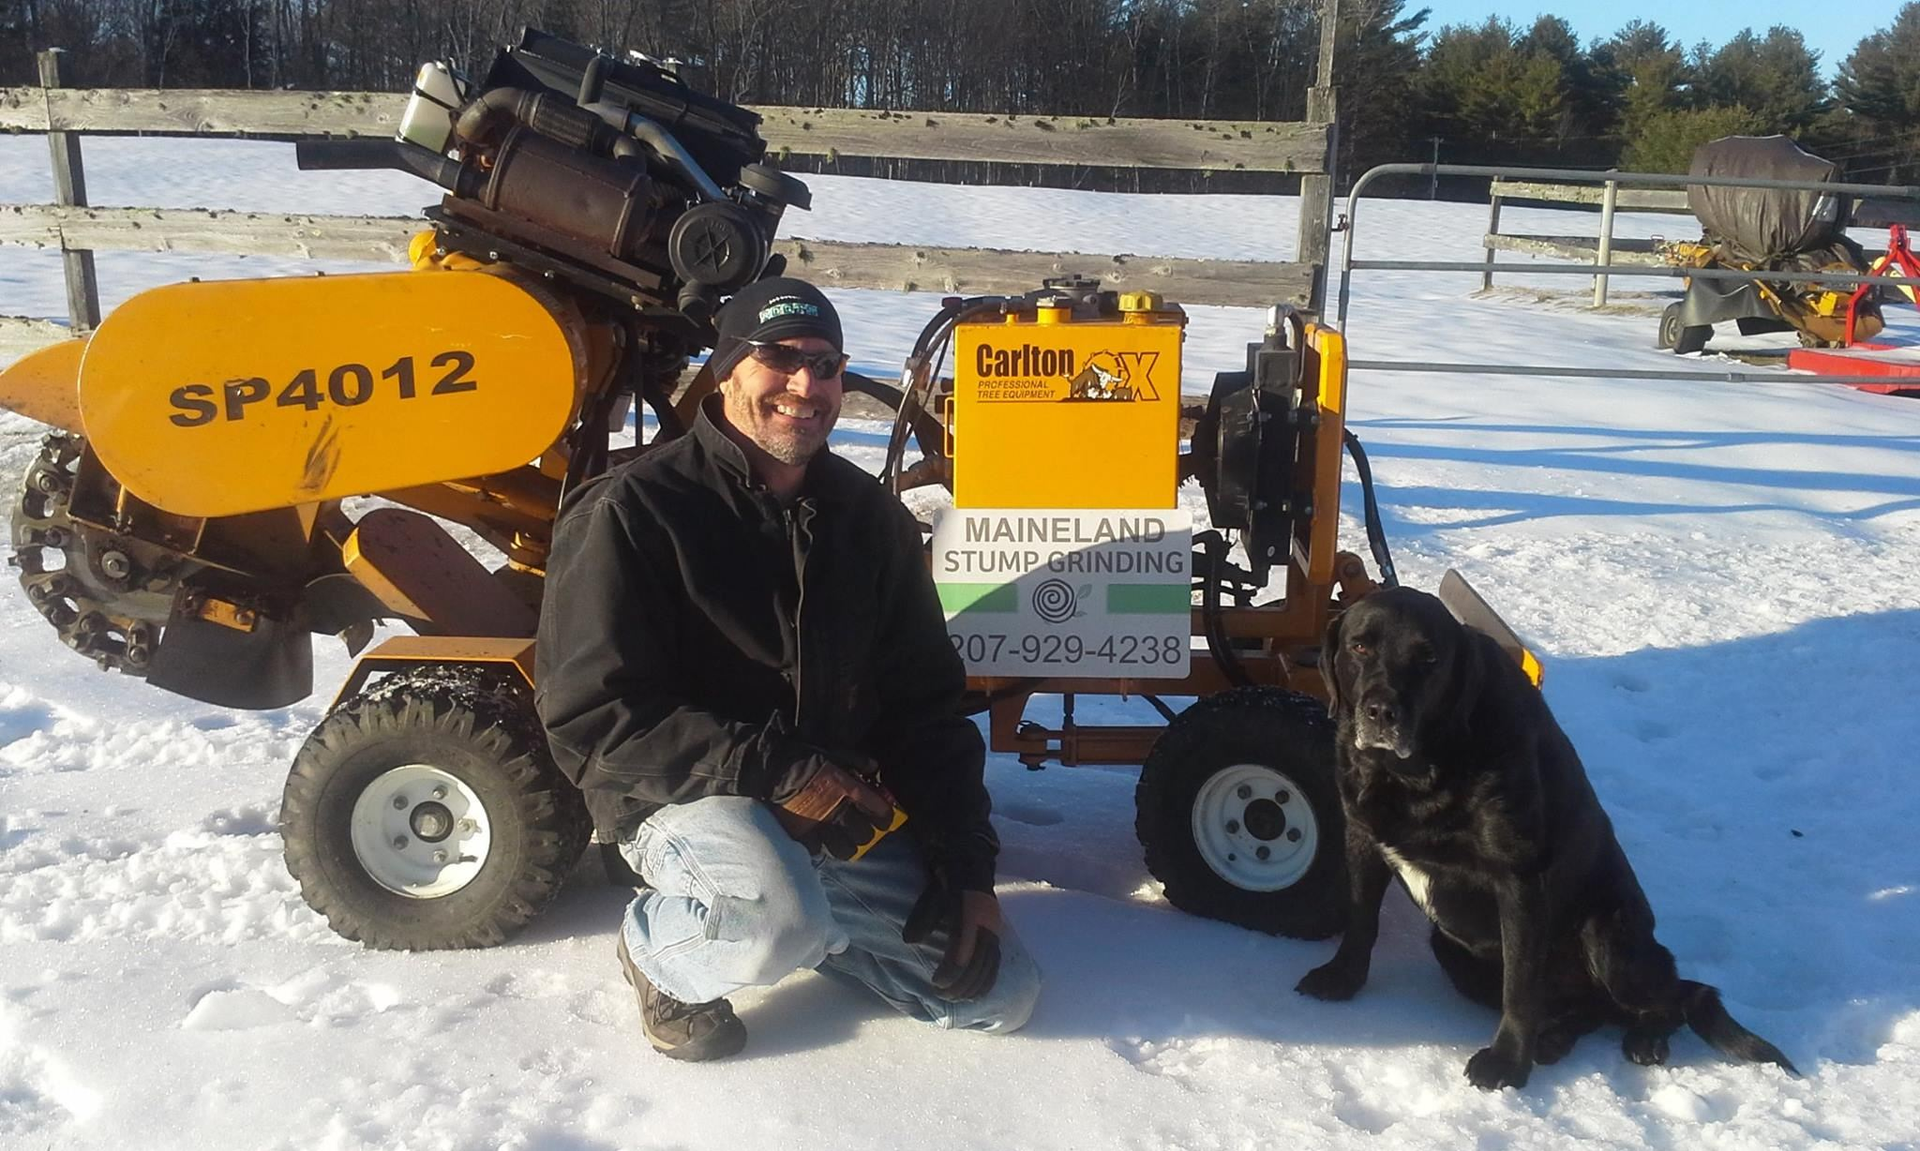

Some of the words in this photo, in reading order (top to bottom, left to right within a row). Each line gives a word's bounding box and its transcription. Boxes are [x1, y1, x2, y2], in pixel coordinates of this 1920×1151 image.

[976, 343, 1074, 378] Carlton
[168, 350, 477, 428] SP4012
[977, 380, 1049, 389] PROFESSIONAL
[977, 390, 1000, 399] TREE
[1002, 390, 1056, 399] EQUIPMENT
[965, 517, 1166, 543] MAINELAND
[944, 550, 1040, 573] STUMP
[1047, 551, 1183, 574] GRINDING
